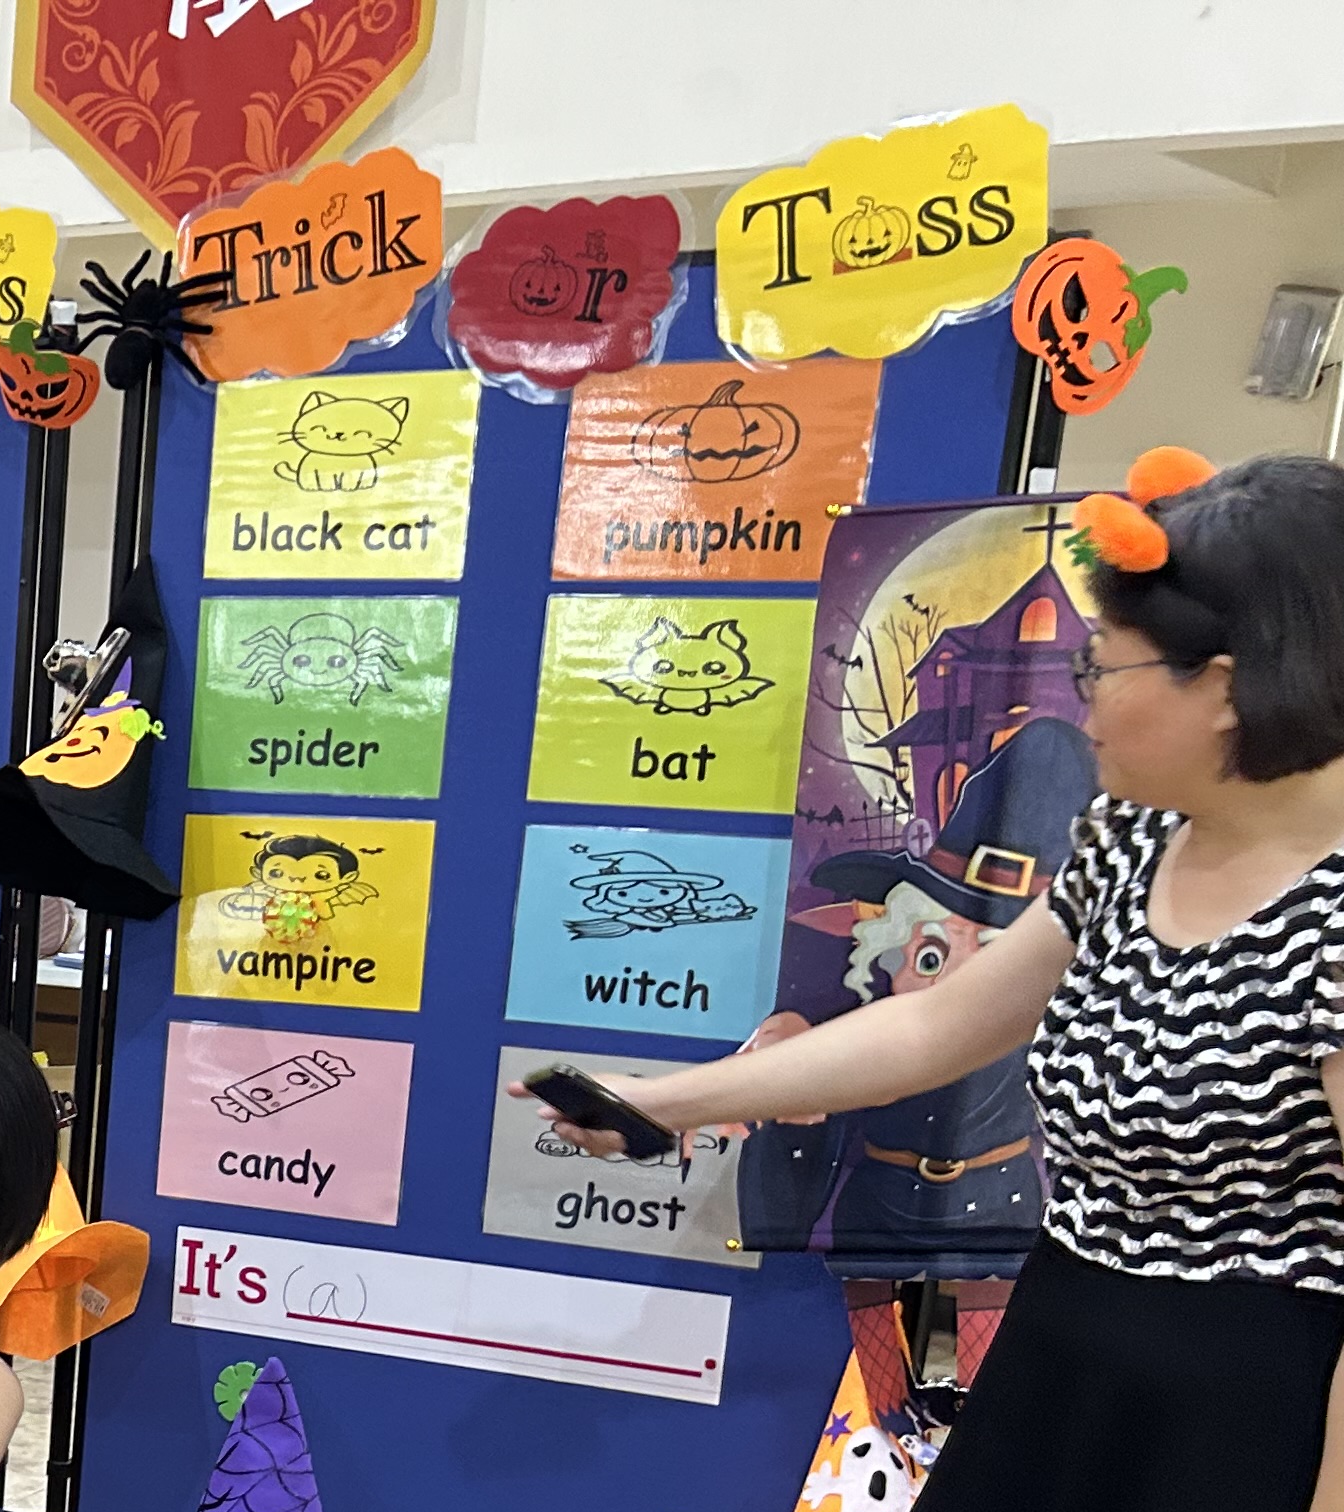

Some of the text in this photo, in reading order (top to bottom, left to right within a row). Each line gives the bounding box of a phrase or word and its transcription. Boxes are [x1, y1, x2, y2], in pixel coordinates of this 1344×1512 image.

[194, 190, 426, 312] Trick
[232, 511, 436, 552] black cat
[603, 507, 802, 564] pumpkin
[247, 728, 380, 777] spider
[630, 738, 717, 782] bat
[216, 945, 376, 991] vampire
[584, 966, 711, 1012] witch
[217, 1147, 336, 1198] candy
[555, 1182, 687, 1232] ghost
[178, 1239, 267, 1304] It's
[283, 1265, 368, 1322] (a)
